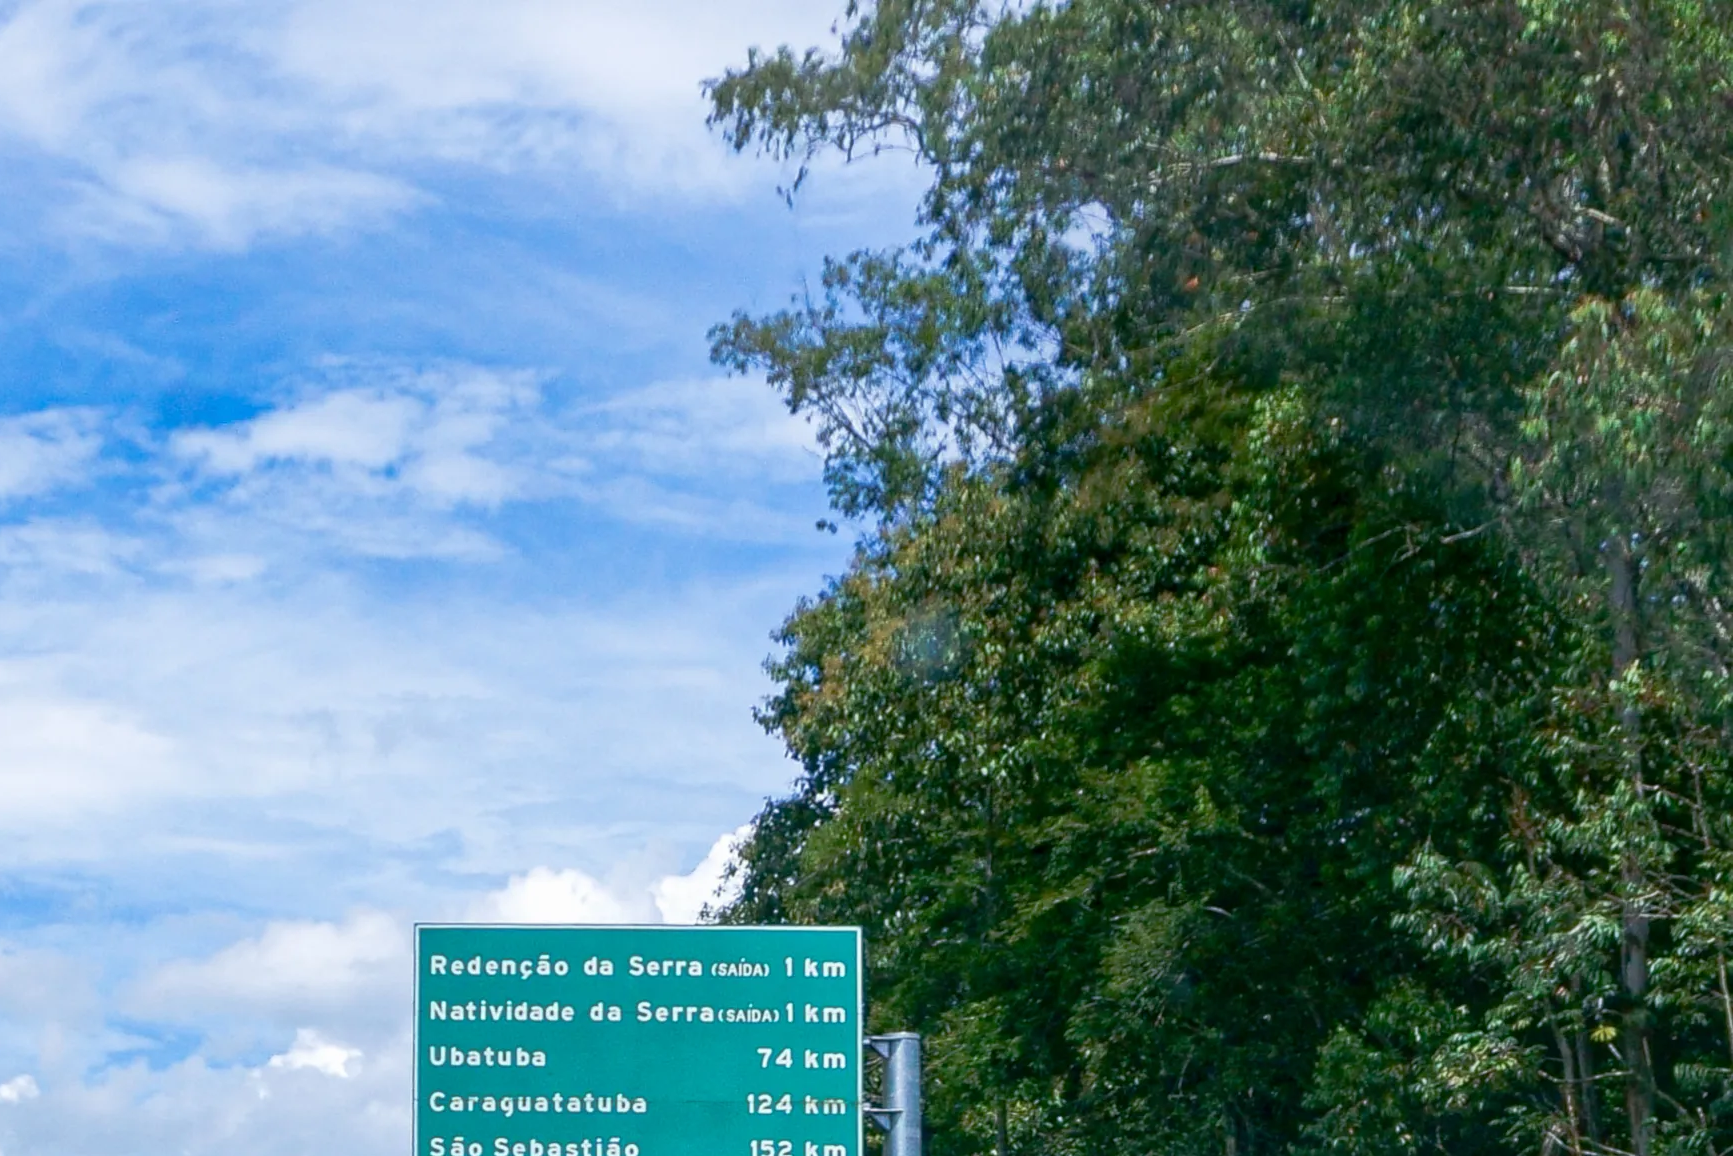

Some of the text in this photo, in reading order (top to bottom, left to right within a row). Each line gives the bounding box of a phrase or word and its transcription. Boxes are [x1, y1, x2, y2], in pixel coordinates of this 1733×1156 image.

[430, 954, 846, 980] Redenção da Serra (SAÍDA) 1 km
[429, 999, 846, 1023] Natividade da Serra (SAÍDA) 1 km
[429, 1046, 846, 1069] Ubatuba 74 km
[429, 1091, 846, 1118] Caraguatatuba 124 km
